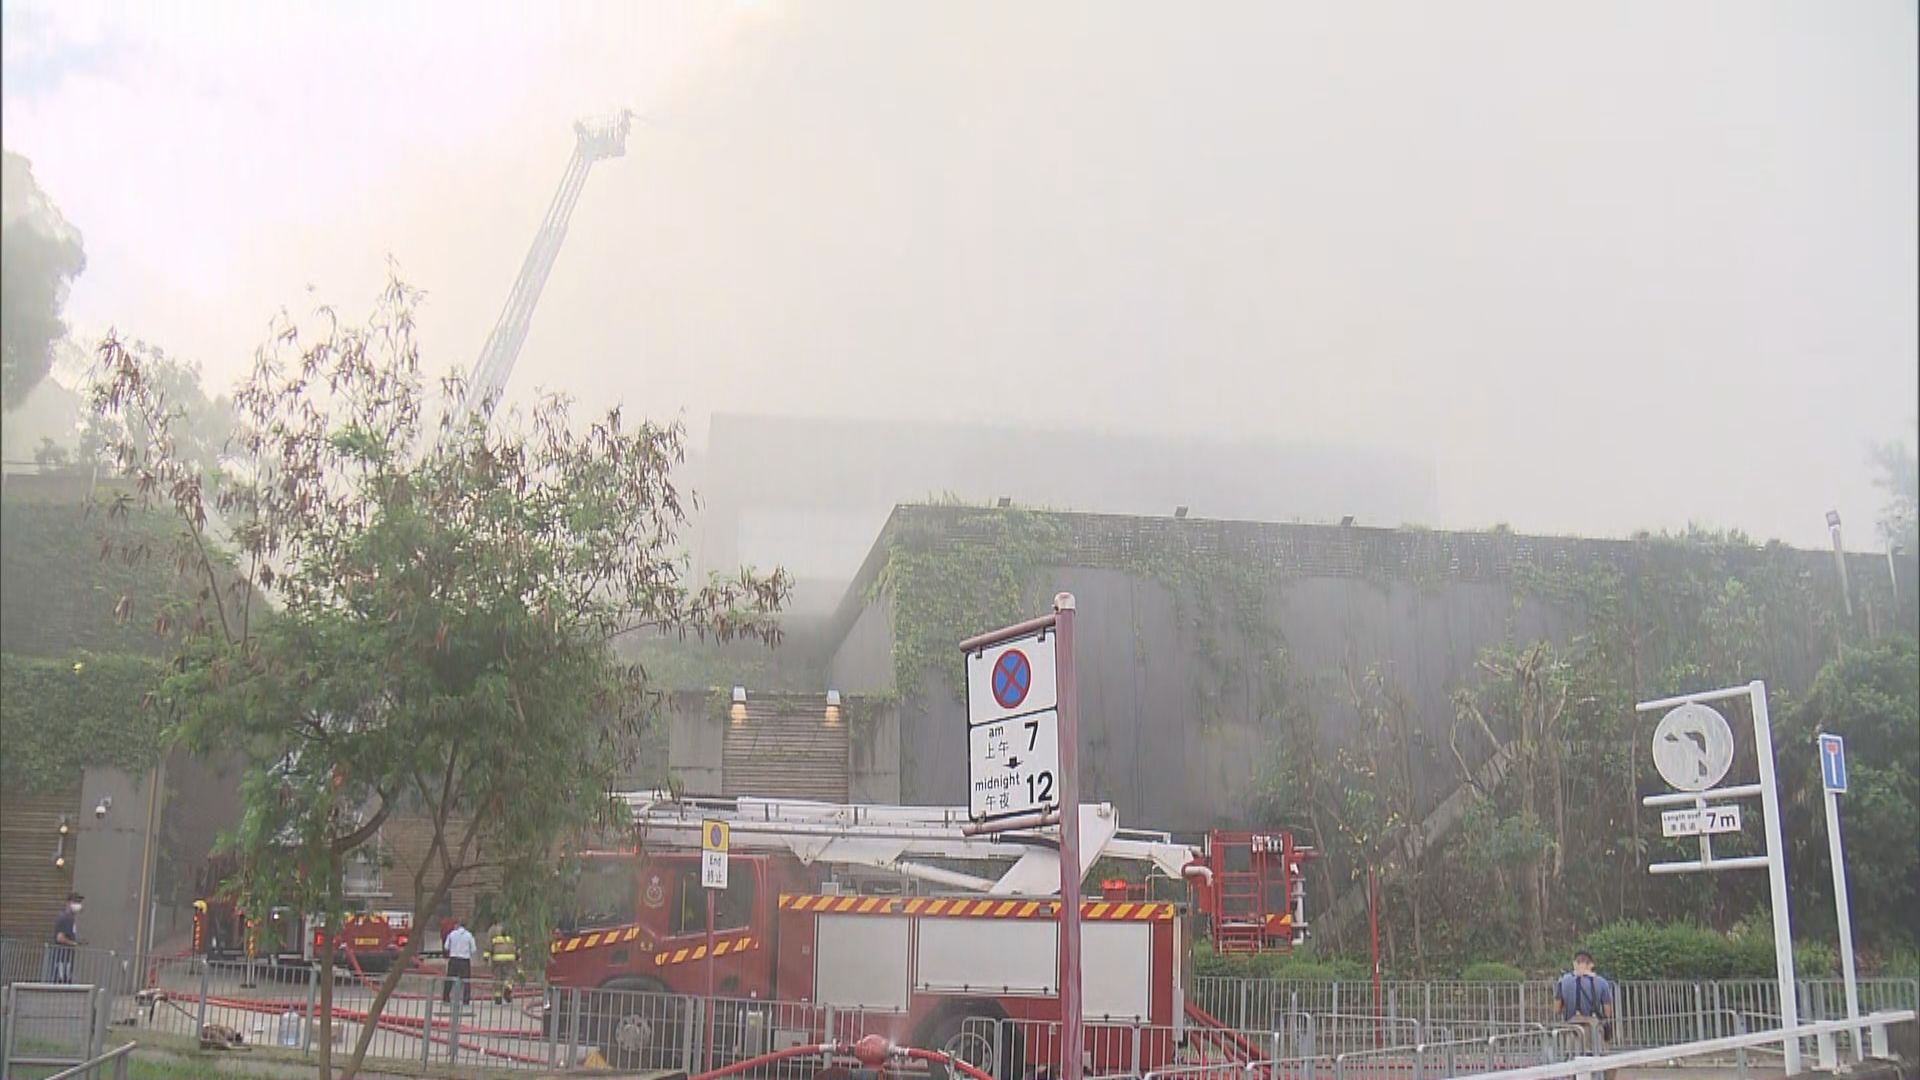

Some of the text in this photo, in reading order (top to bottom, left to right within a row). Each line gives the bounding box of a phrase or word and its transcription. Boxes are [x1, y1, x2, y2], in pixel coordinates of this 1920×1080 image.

[988, 720, 1039, 752] am 7
[985, 741, 1009, 760] 上午
[975, 771, 1053, 804] midnight 12
[985, 792, 1010, 811] 午夜
